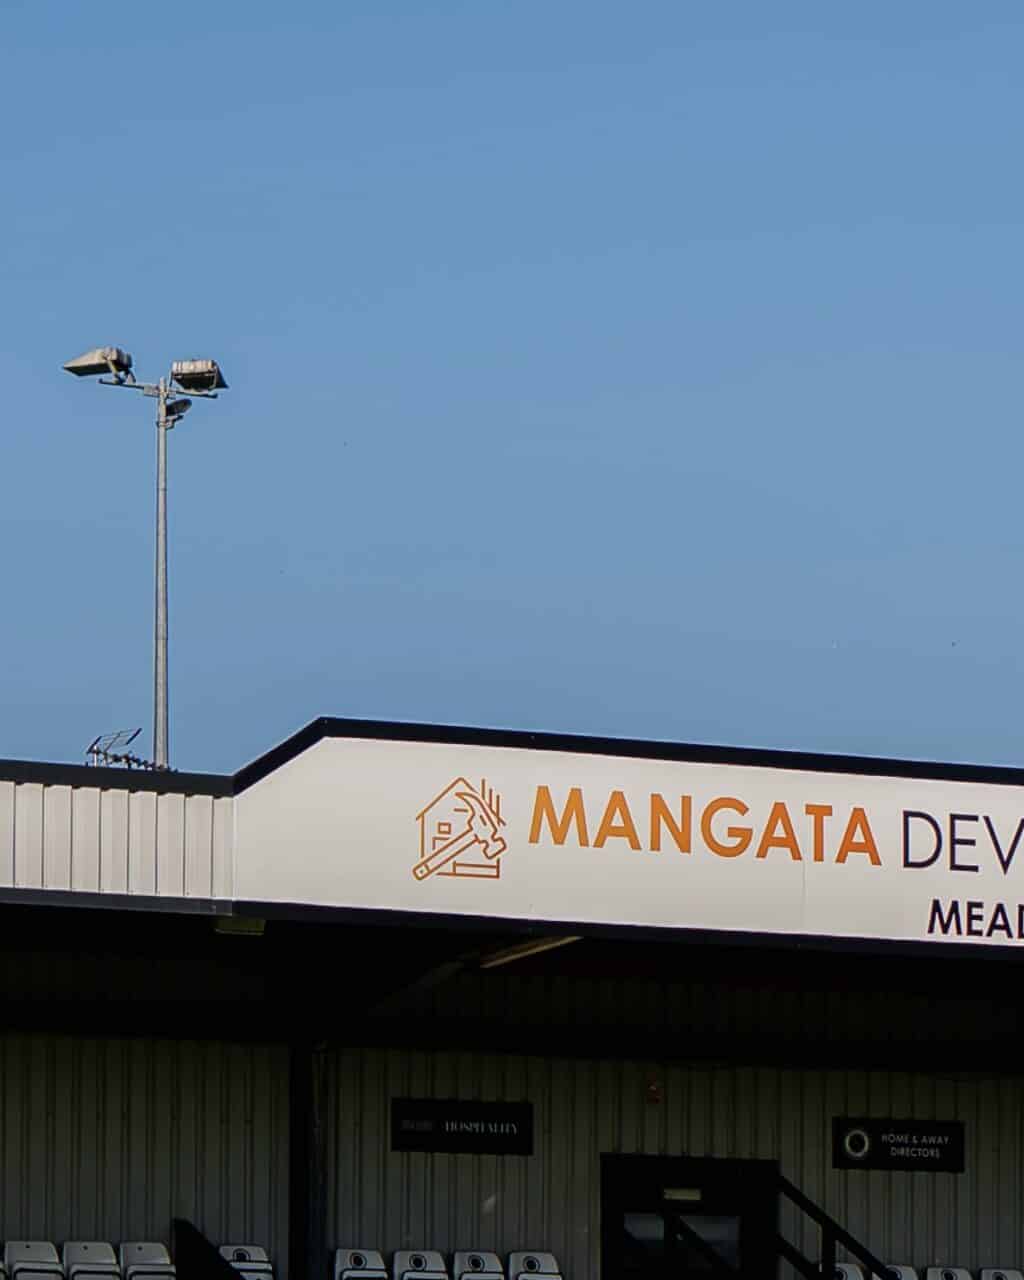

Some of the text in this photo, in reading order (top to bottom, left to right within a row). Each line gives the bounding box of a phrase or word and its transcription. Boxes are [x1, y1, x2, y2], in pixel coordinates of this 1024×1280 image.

[528, 785, 882, 867] MANGATA
[881, 1133, 909, 1145] HOME
[921, 1135, 950, 1146] AWAY
[889, 1146, 941, 1159] DIRECTORS
